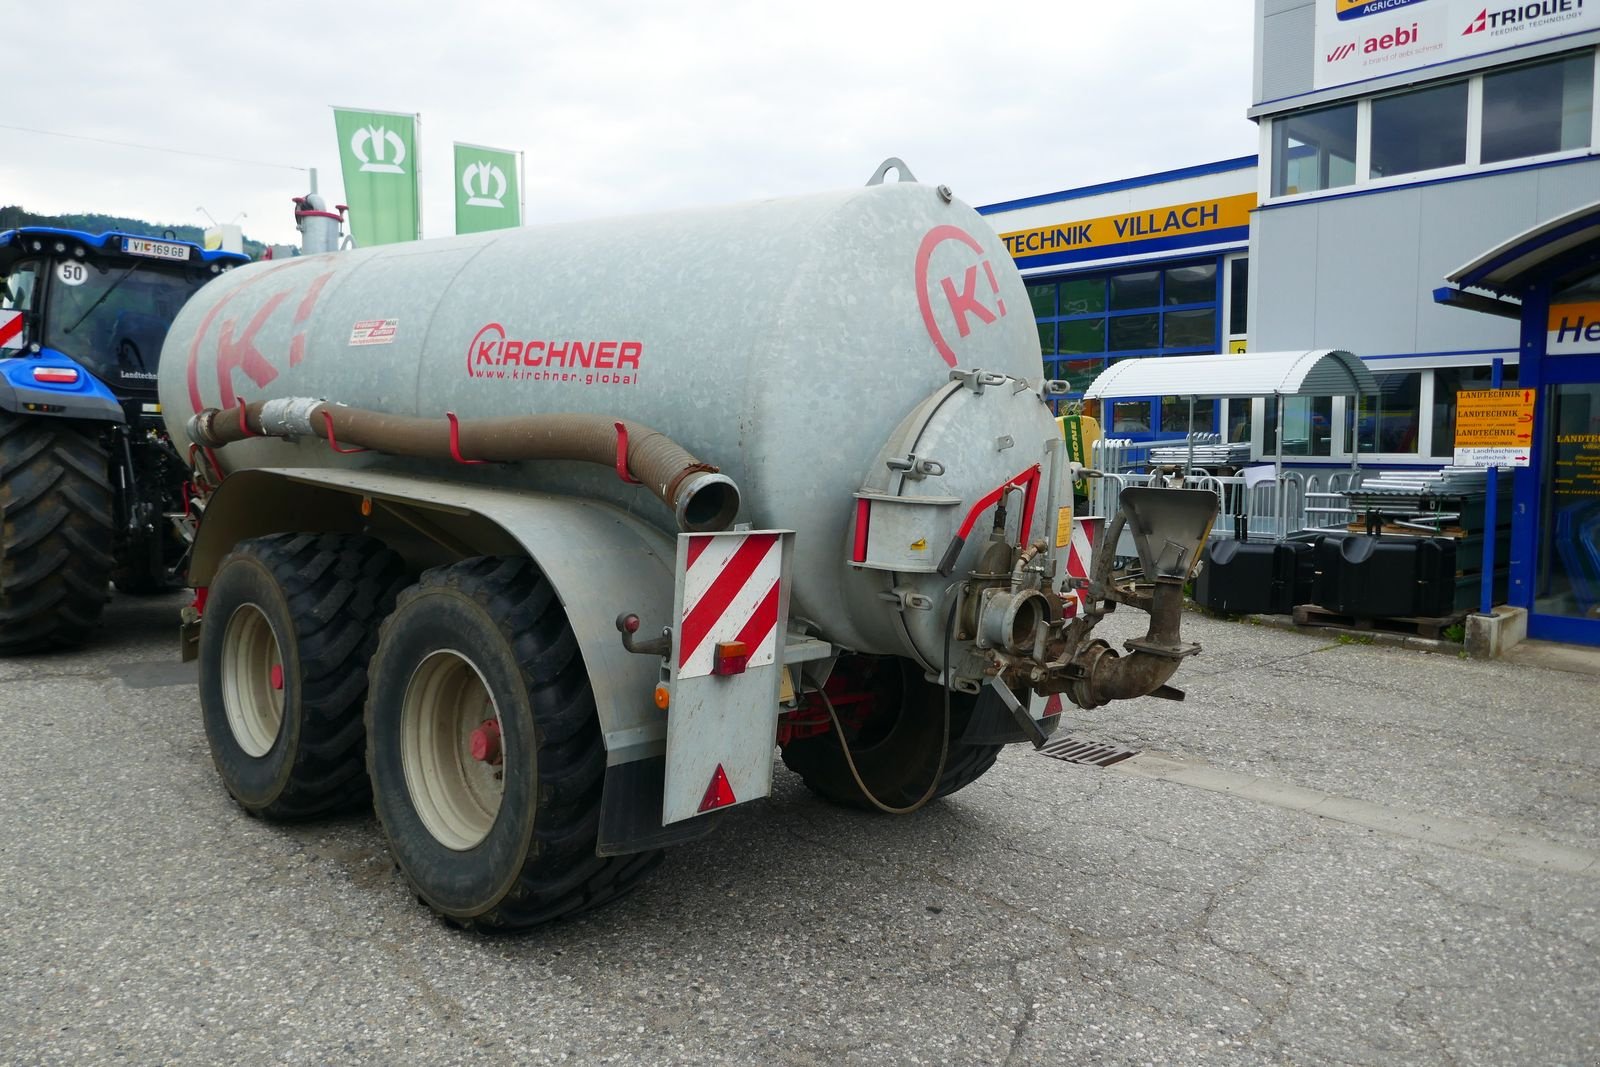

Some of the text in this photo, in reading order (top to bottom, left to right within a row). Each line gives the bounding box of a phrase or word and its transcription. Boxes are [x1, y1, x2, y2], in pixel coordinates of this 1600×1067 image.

[1363, 0, 1412, 13] AGRICUL
[1490, 11, 1583, 37] FEEDING TECHNOLOGY
[1363, 23, 1418, 54] aebi
[1368, 55, 1389, 65] brand
[1002, 204, 1219, 253] TECHNIK VILLACH
[133, 241, 184, 257] VI 169 GB
[63, 265, 82, 281] 50
[474, 368, 639, 385] www.kirchner.global
[1460, 391, 1521, 399] LANDTECHNIK
[1458, 410, 1519, 418] LANDTECHNIK
[1456, 429, 1516, 437] LANDTECHNIK
